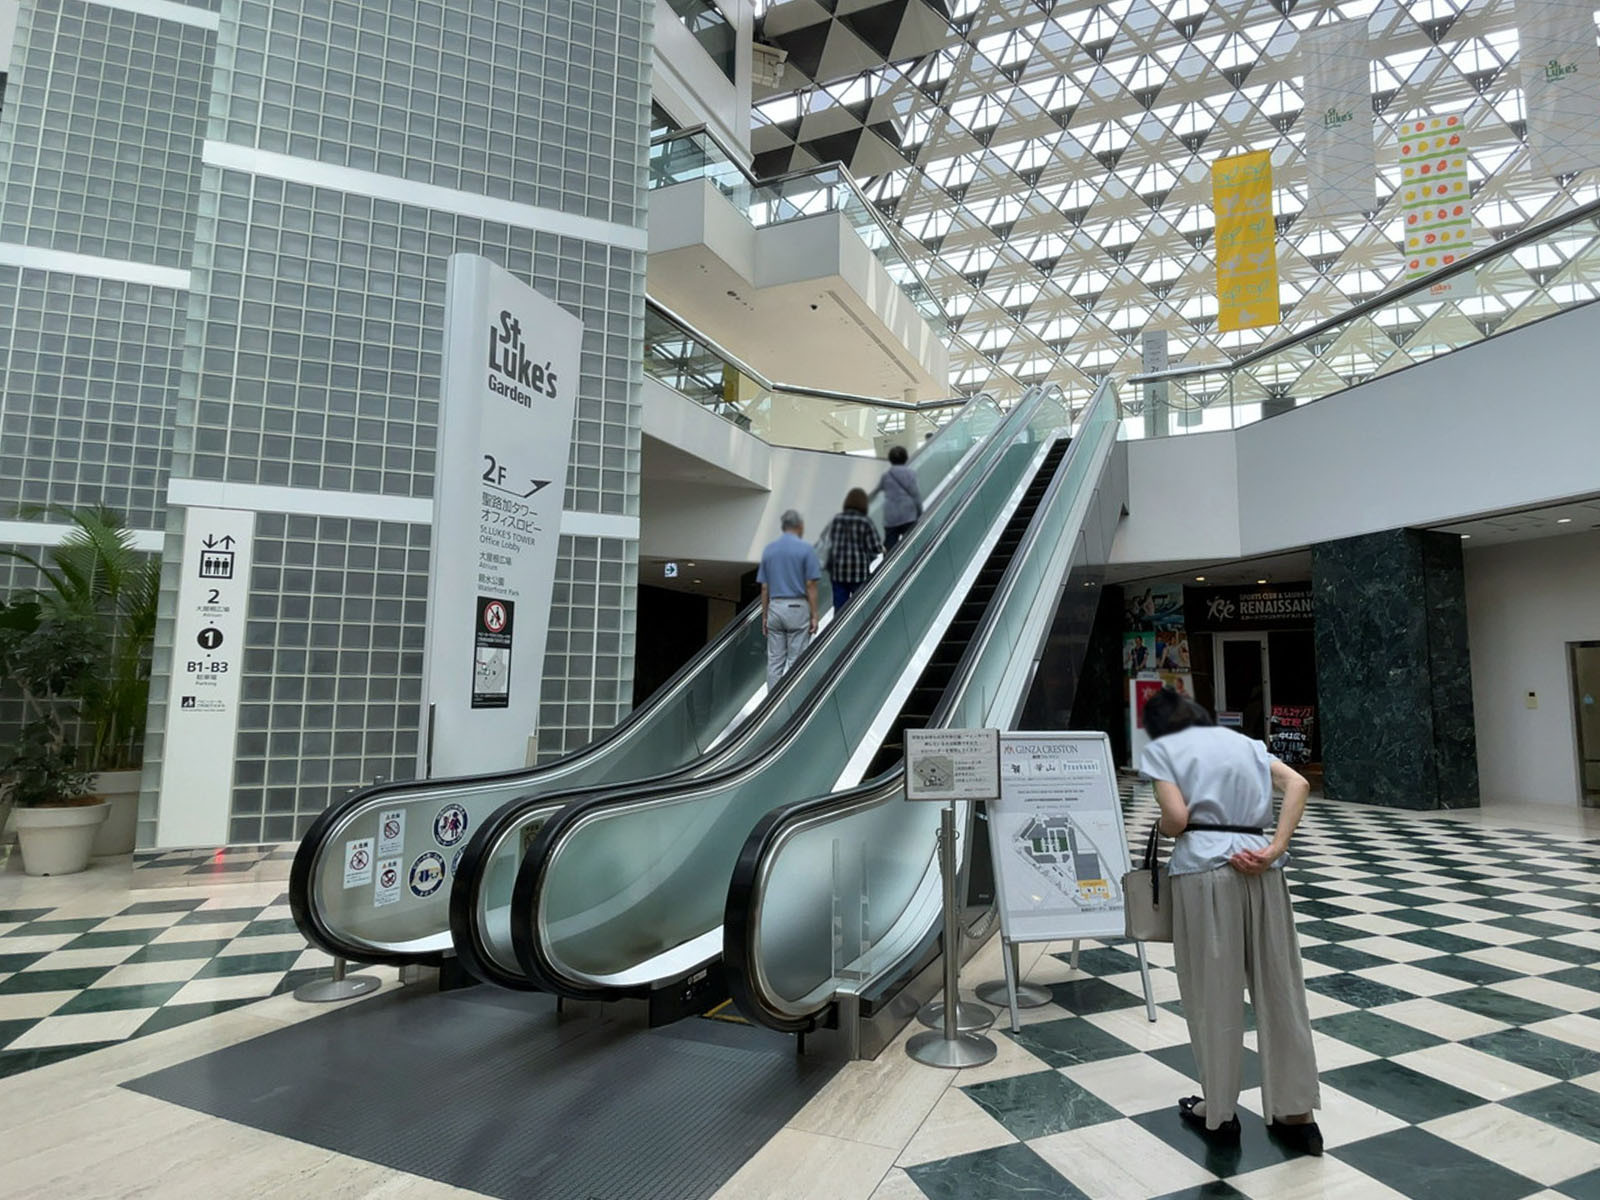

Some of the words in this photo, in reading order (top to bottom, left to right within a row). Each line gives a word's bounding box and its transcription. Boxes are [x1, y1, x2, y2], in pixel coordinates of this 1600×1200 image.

[499, 310, 521, 350] St
[488, 325, 557, 399] Luke's
[488, 374, 531, 408] Garden
[482, 454, 507, 486] 2F
[481, 491, 538, 517] 聖路加タワー
[481, 508, 542, 533] オフィスロビー
[479, 534, 500, 547] Office
[501, 540, 521, 553] Lobby
[512, 532, 536, 546] TOWER
[208, 589, 220, 604] 2
[204, 631, 215, 647] 1
[187, 661, 229, 673] B1-B3
[1015, 745, 1042, 754] GINZA
[1042, 744, 1079, 754] CRESTON
